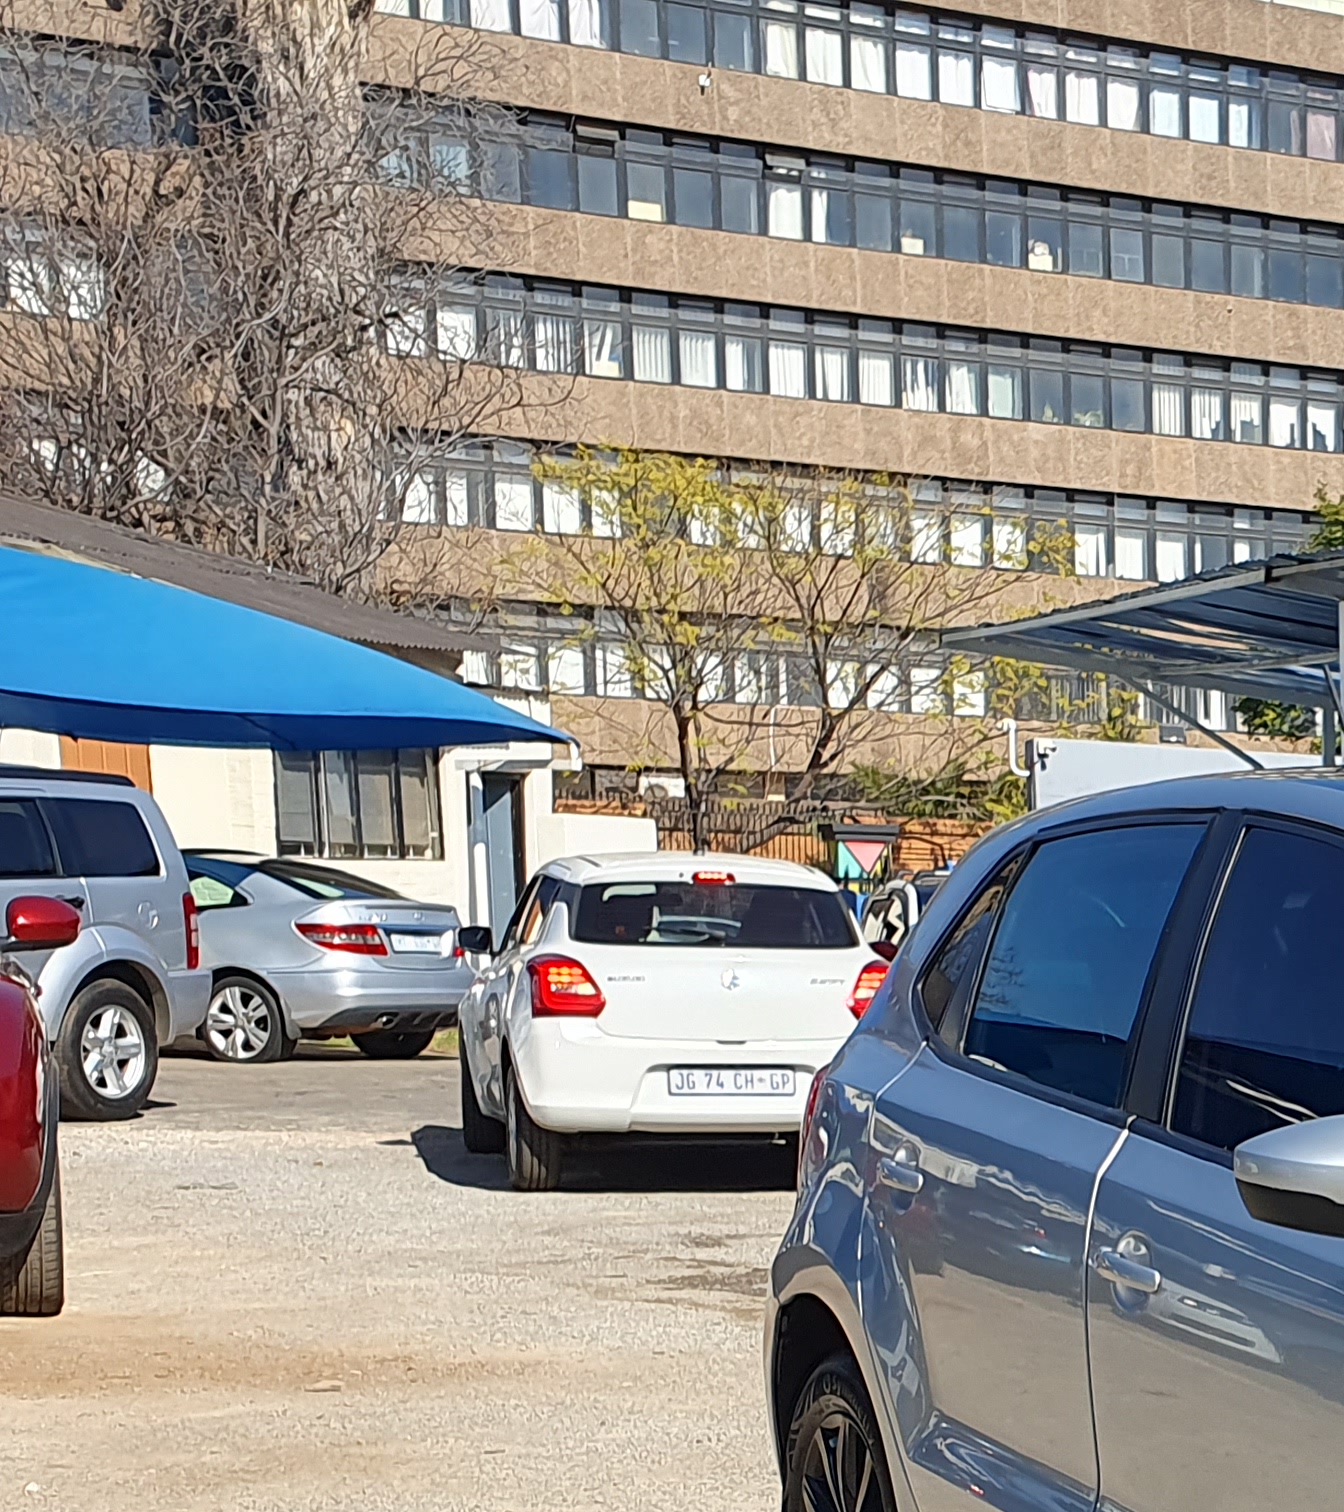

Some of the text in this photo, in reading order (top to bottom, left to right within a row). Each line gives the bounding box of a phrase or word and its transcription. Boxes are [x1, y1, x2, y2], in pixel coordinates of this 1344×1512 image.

[675, 1072, 790, 1090] JG 74 CH GP
